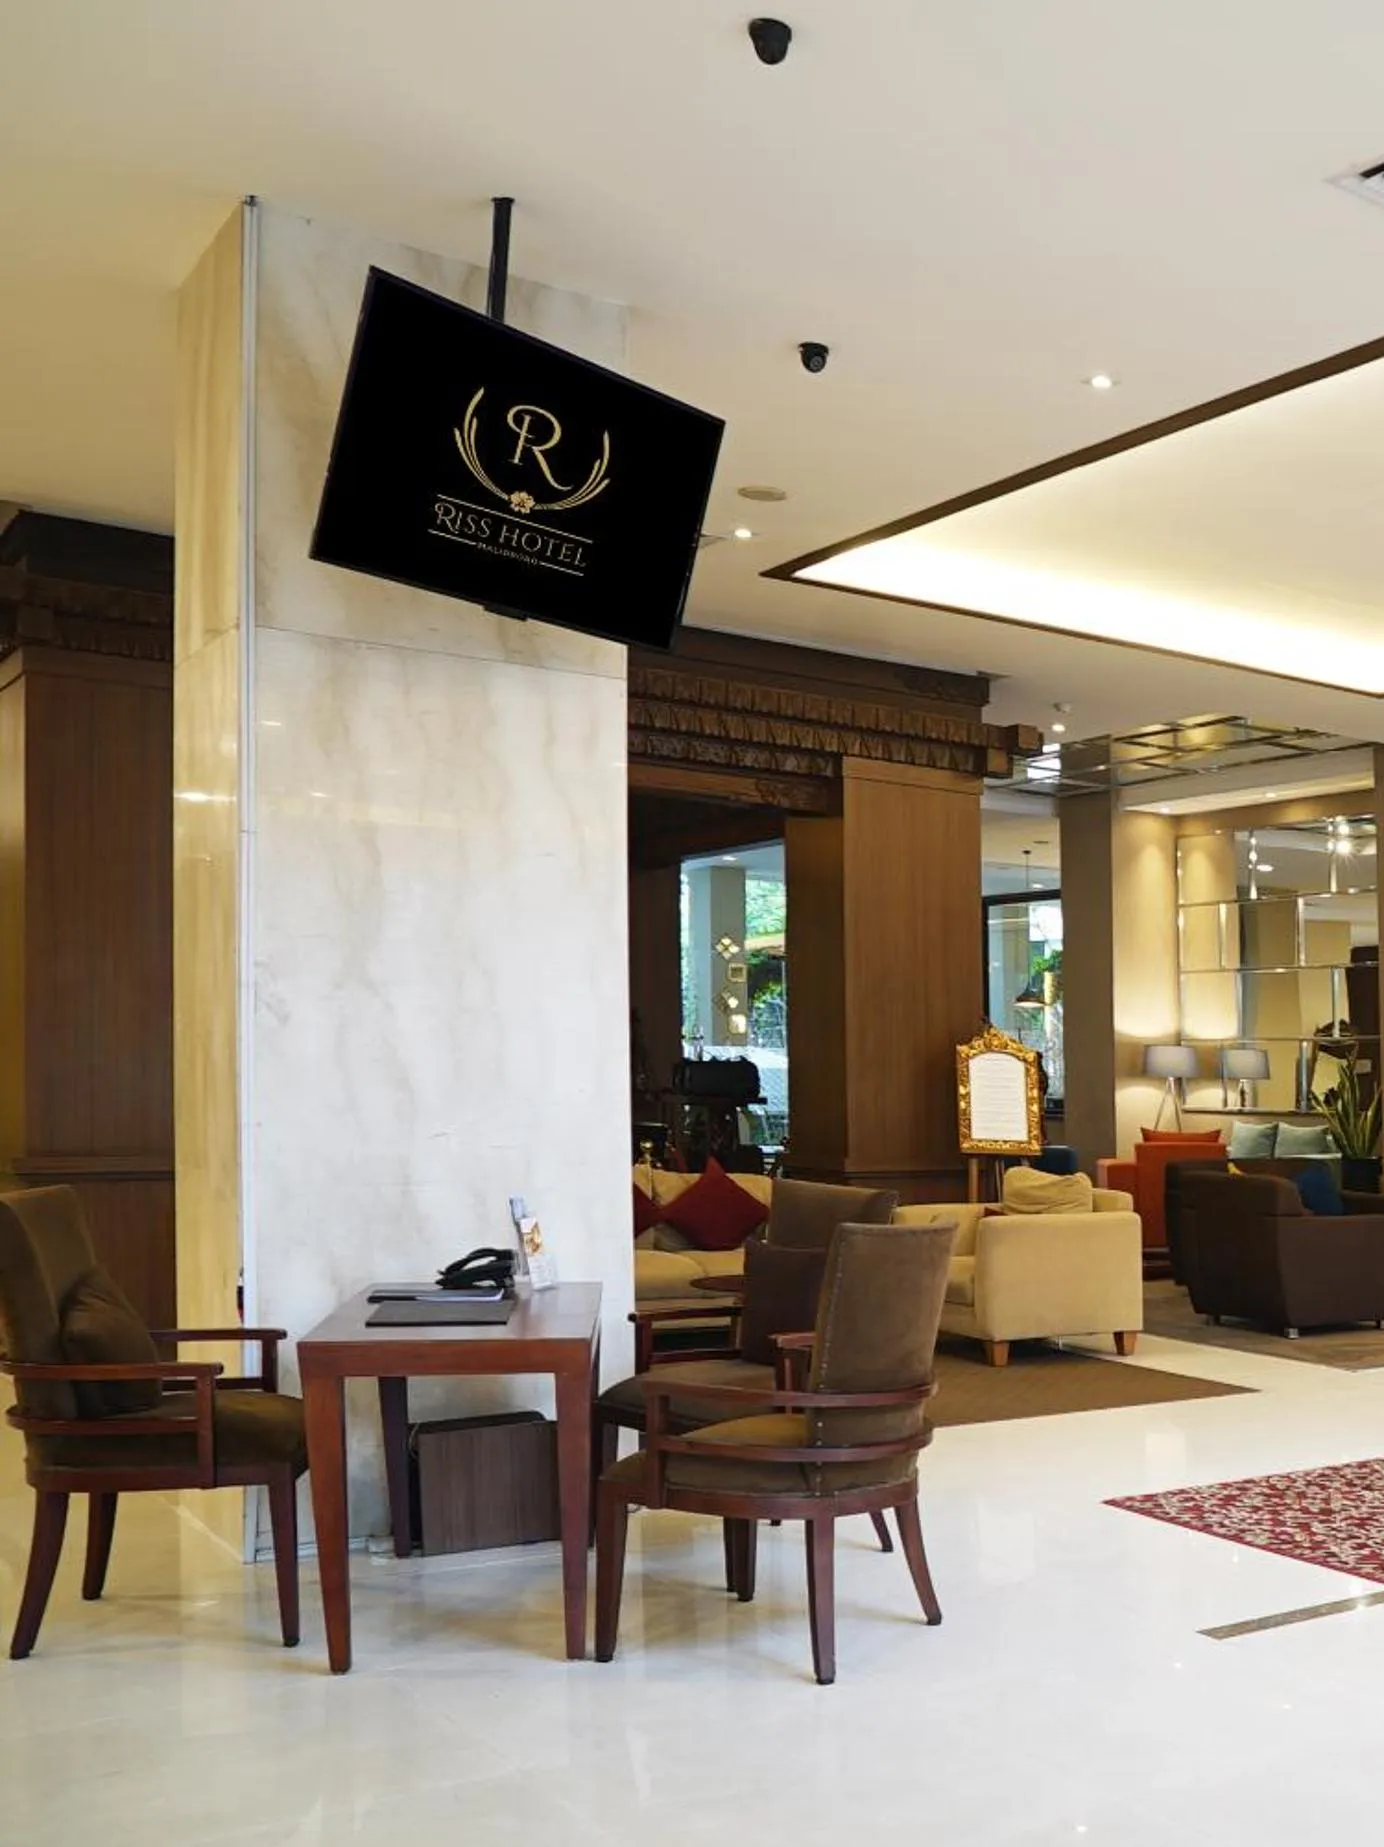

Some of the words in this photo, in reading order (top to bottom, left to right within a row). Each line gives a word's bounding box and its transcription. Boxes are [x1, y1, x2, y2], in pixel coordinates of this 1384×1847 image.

[505, 404, 573, 491] R
[433, 501, 493, 538] RISS
[499, 524, 587, 567] HOTEL
